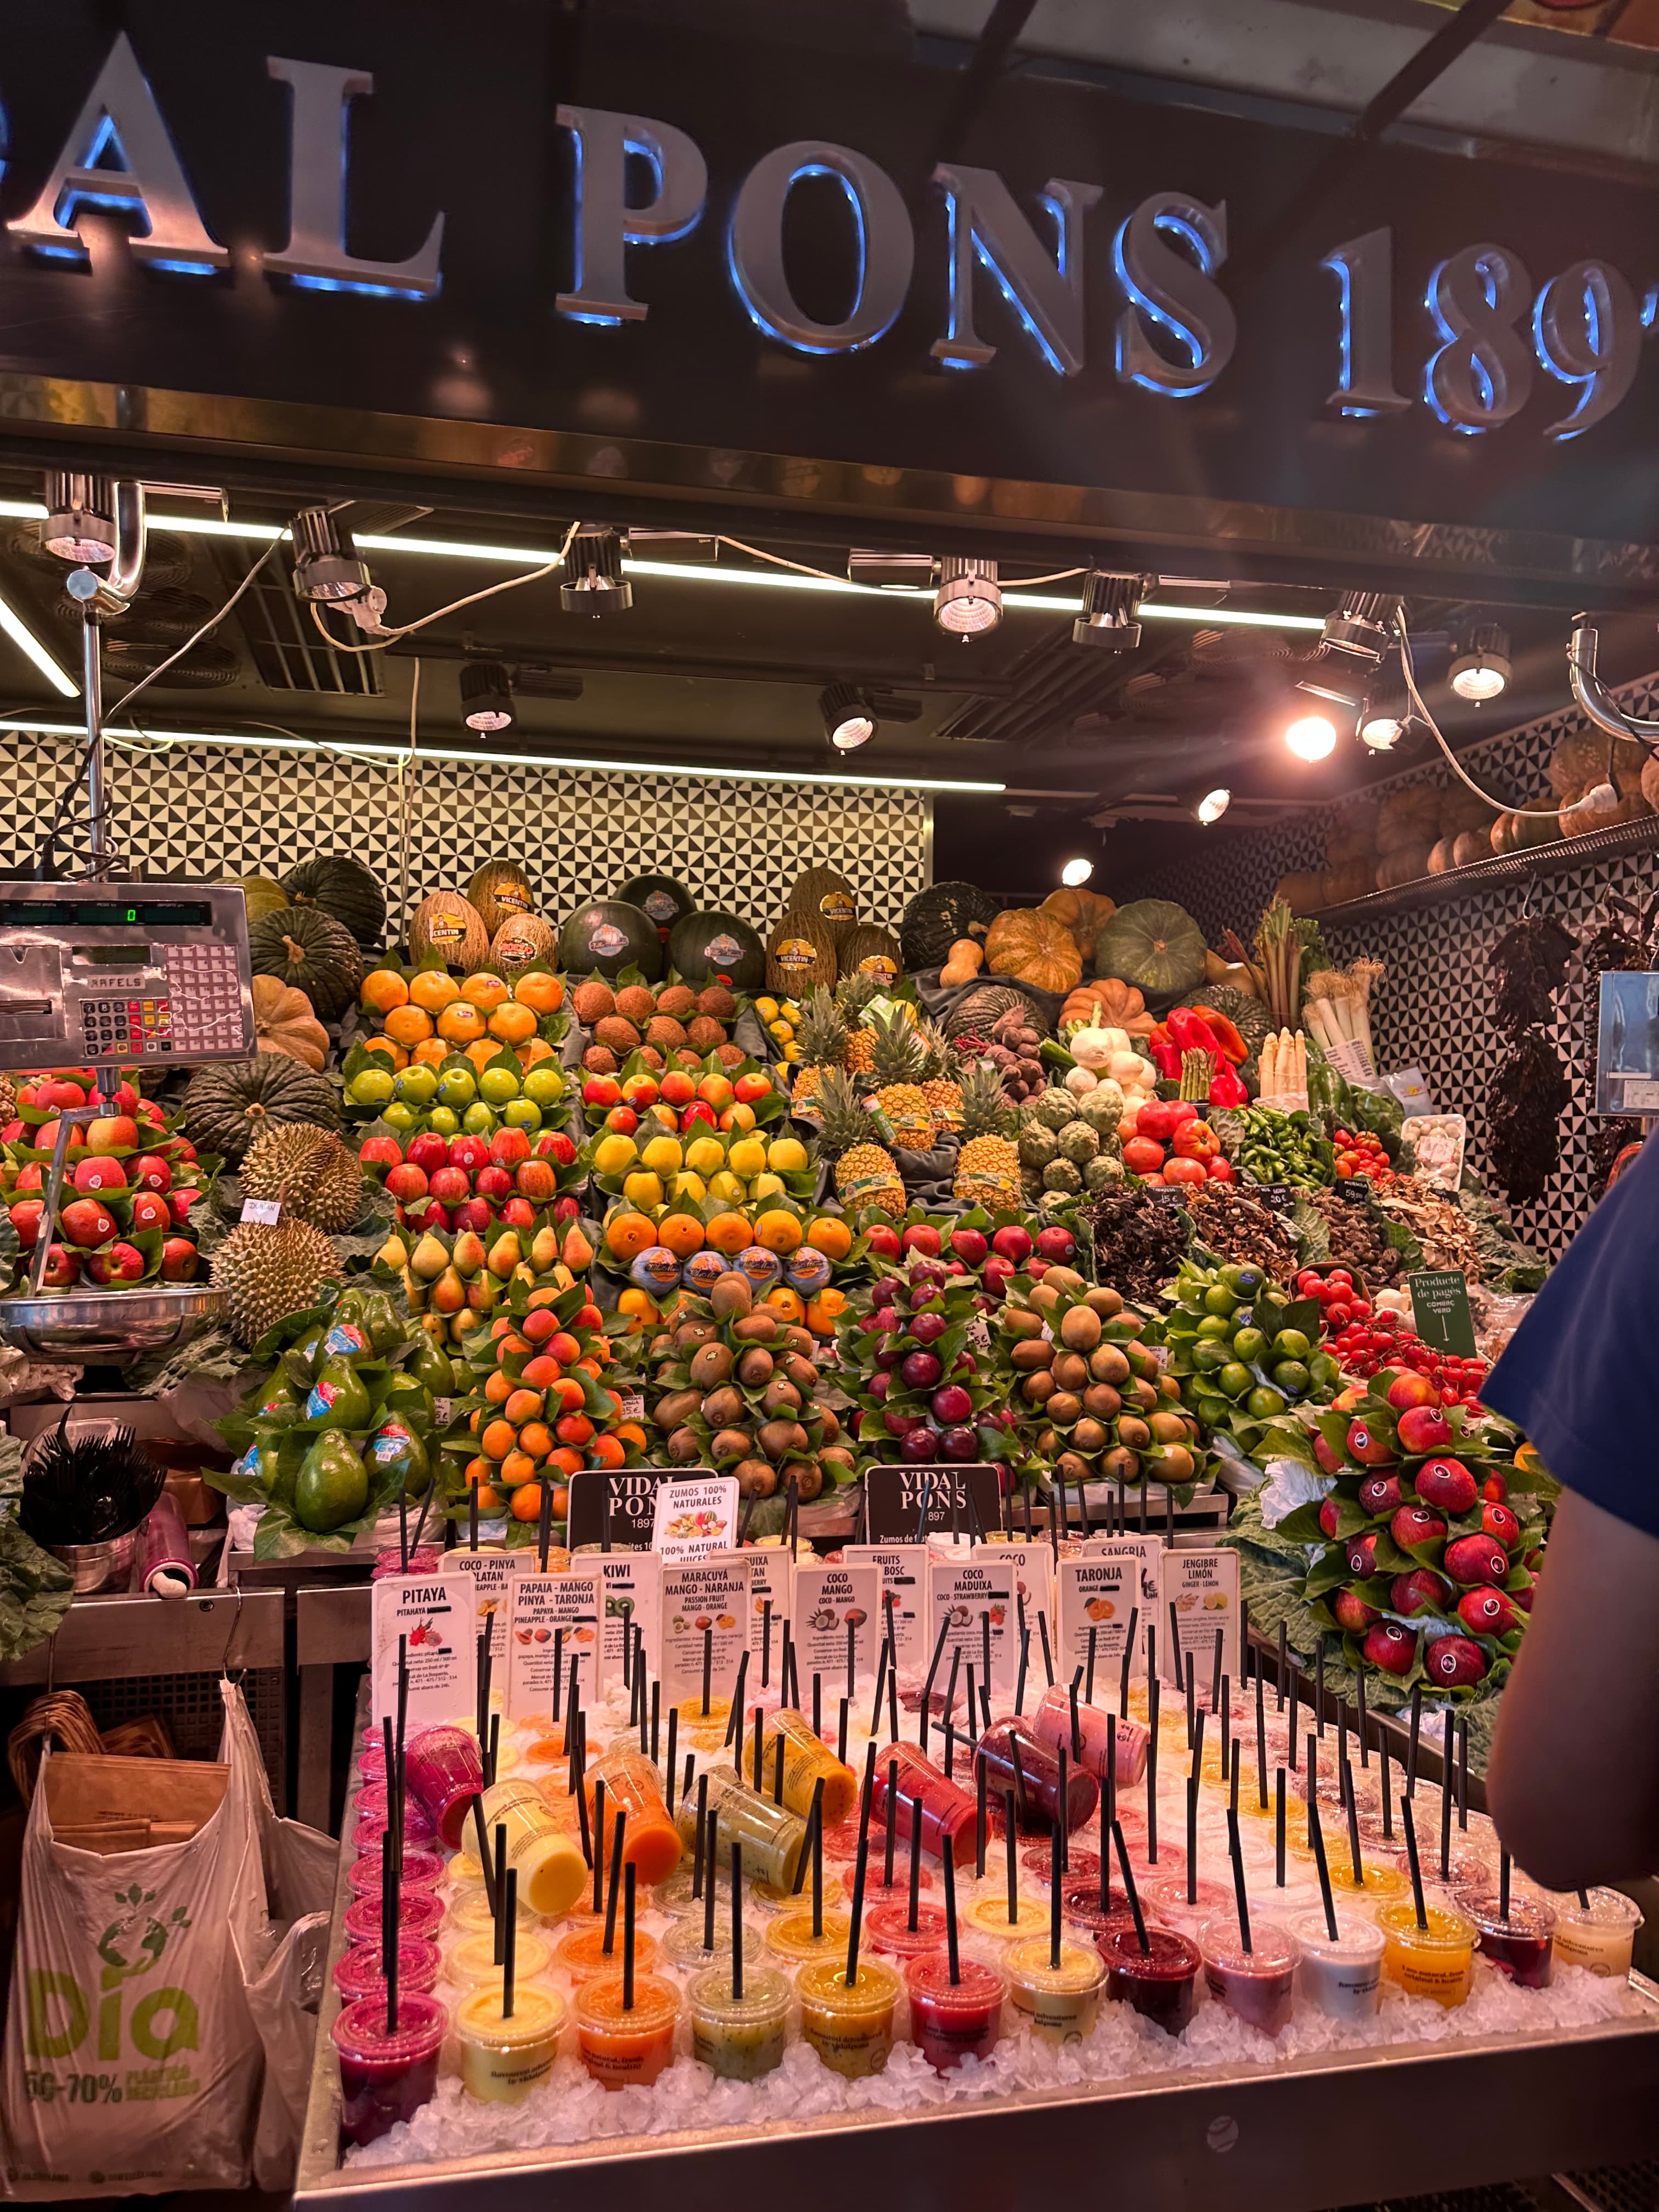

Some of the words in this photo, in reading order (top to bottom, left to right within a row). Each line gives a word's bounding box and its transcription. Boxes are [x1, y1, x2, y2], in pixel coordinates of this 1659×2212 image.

[0, 30, 445, 298] AL
[556, 104, 1237, 396] PONS
[1322, 227, 1659, 440] 189
[501, 896, 528, 909] VICENTIN
[128, 910, 135, 921] 0
[249, 1202, 276, 1212] DURIAN
[1415, 1276, 1459, 1288] Producte
[1418, 1289, 1430, 1299] de
[899, 1472, 966, 1490] VIDAL
[669, 1487, 698, 1498] ZUMOS
[703, 1485, 727, 1496] 100%
[673, 1496, 722, 1509] NATURALES
[900, 1491, 966, 1509] PONS
[609, 1497, 657, 1516] PON
[927, 1511, 945, 1521] 897
[631, 1519, 655, 1528] 1897
[879, 1535, 903, 1544] Zumos
[904, 1534, 913, 1543] de
[660, 1546, 684, 1555] 100%
[689, 1541, 728, 1553] NATURAL
[459, 1560, 482, 1572] COCO
[489, 1559, 515, 1570] PINYA
[873, 1556, 900, 1565] FRUITS
[1182, 1559, 1218, 1568] JENGIBRE
[603, 1564, 630, 1578] KIWI
[681, 1569, 728, 1583] MARACUYÁ
[884, 1566, 905, 1575] BOSC
[963, 1570, 984, 1579] COCO
[1075, 1567, 1122, 1582] TARONJA
[1188, 1567, 1212, 1579] LIMÓN
[827, 1573, 848, 1583] COCO
[520, 1582, 552, 1593] PAPAIA
[560, 1582, 593, 1592] MANGO
[665, 1584, 698, 1595] MANGO
[704, 1582, 744, 1593] NARANJA
[822, 1584, 853, 1595] MANGO
[954, 1581, 992, 1591] MADUIXA
[403, 1587, 447, 1604] PITAYA
[518, 1595, 545, 1606] PINYA
[555, 1594, 594, 1604] TARONJA
[397, 1607, 426, 1616] PITAHAYA
